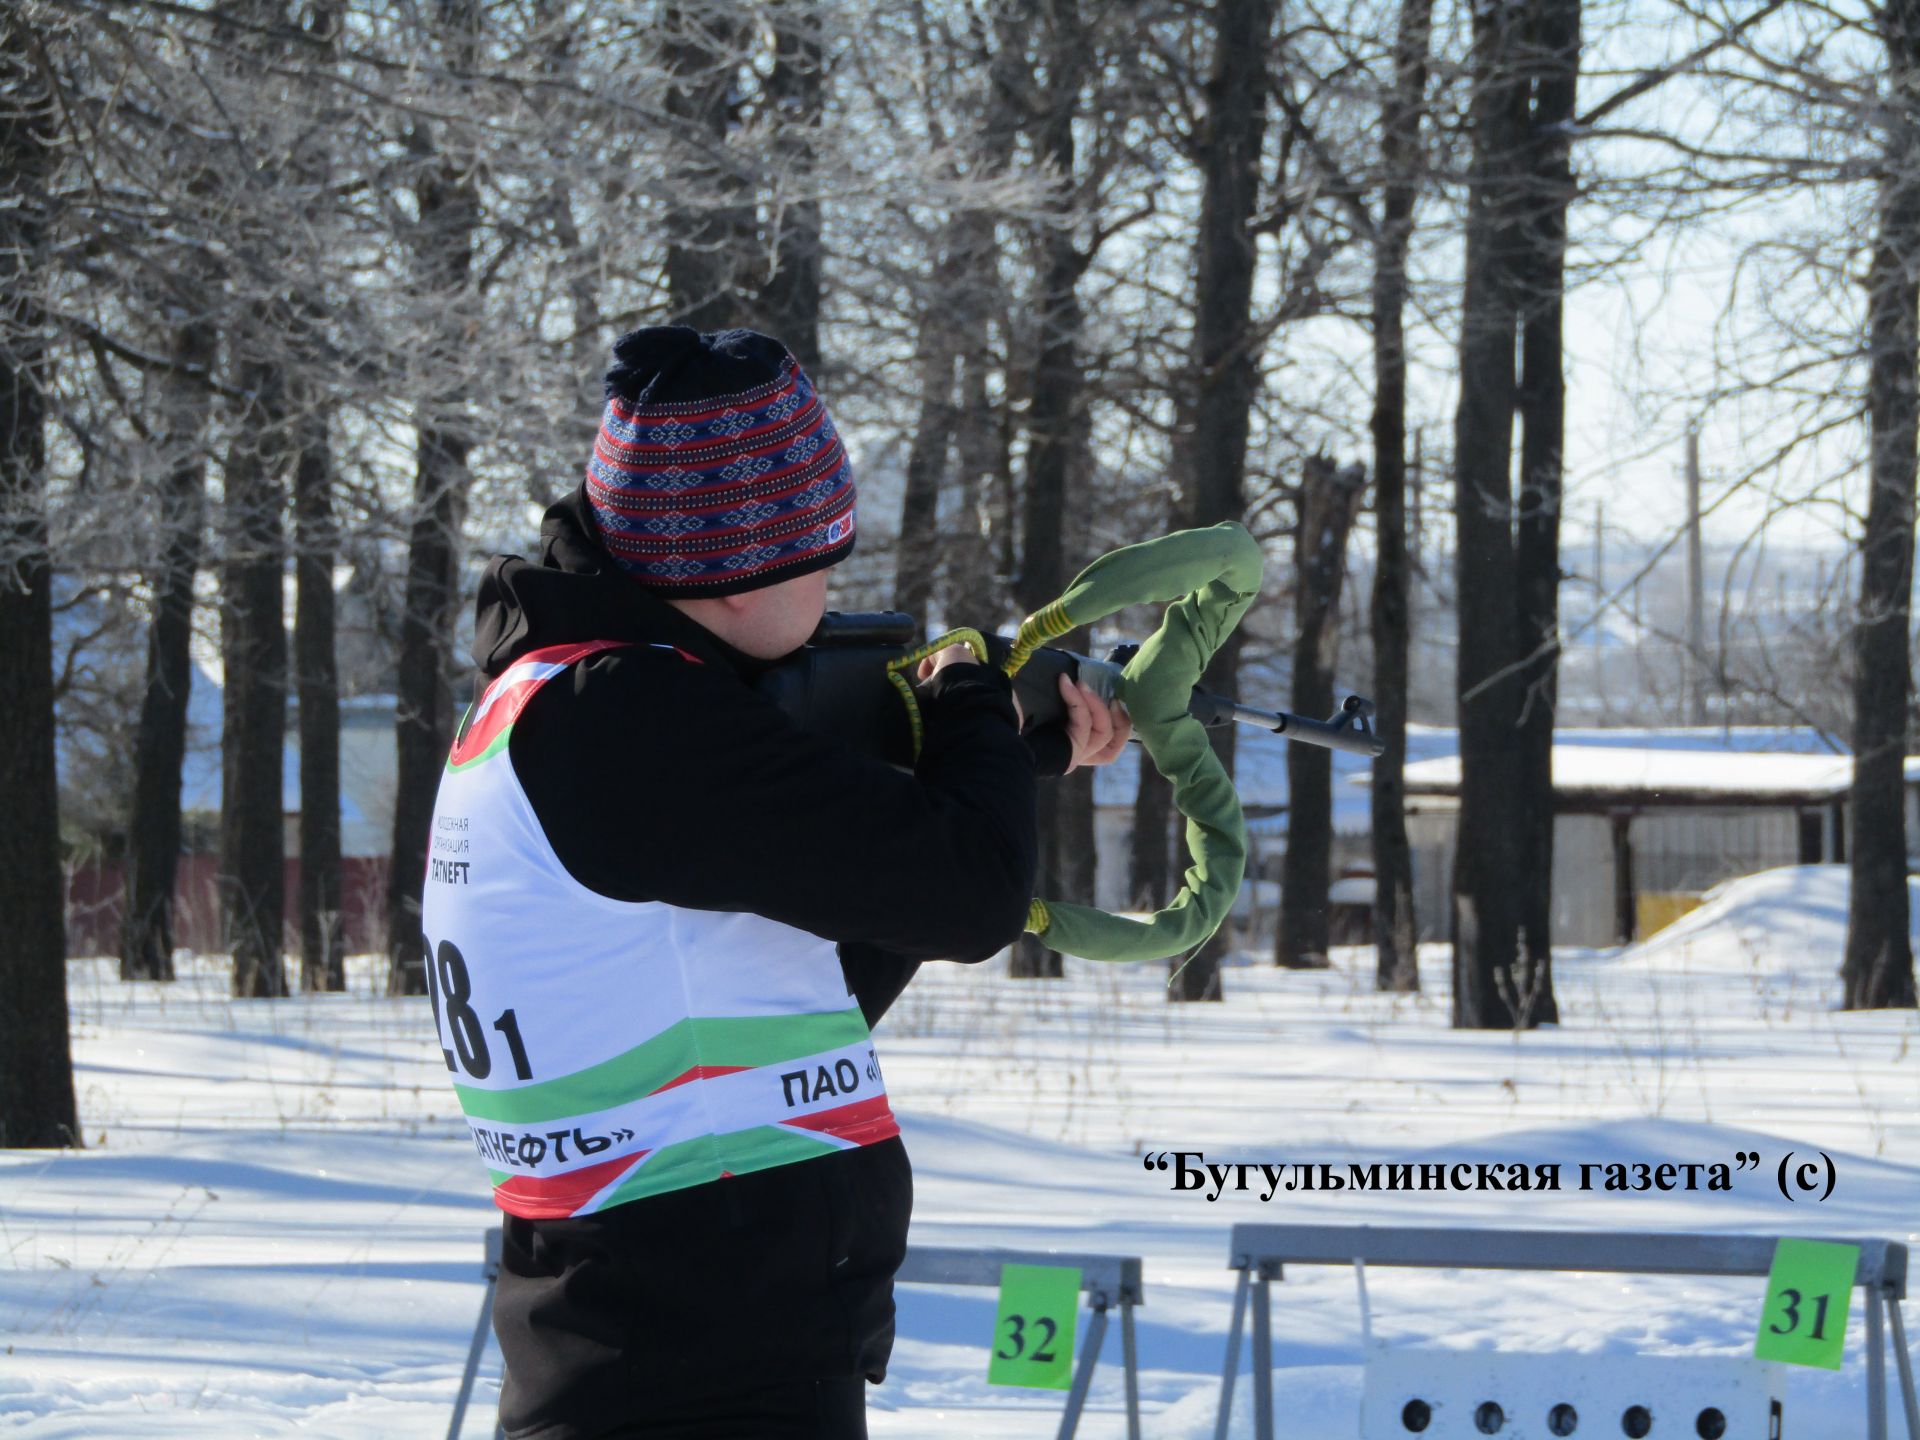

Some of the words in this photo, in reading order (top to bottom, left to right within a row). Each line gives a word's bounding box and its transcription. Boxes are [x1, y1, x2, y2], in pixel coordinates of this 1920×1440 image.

[431, 857, 470, 885] TATNEFT
[780, 1058, 860, 1108] ПАО
[470, 1127, 635, 1169] АТНЕФТЬ»
[996, 1313, 1058, 1363] 32
[1768, 1287, 1830, 1341] 31
